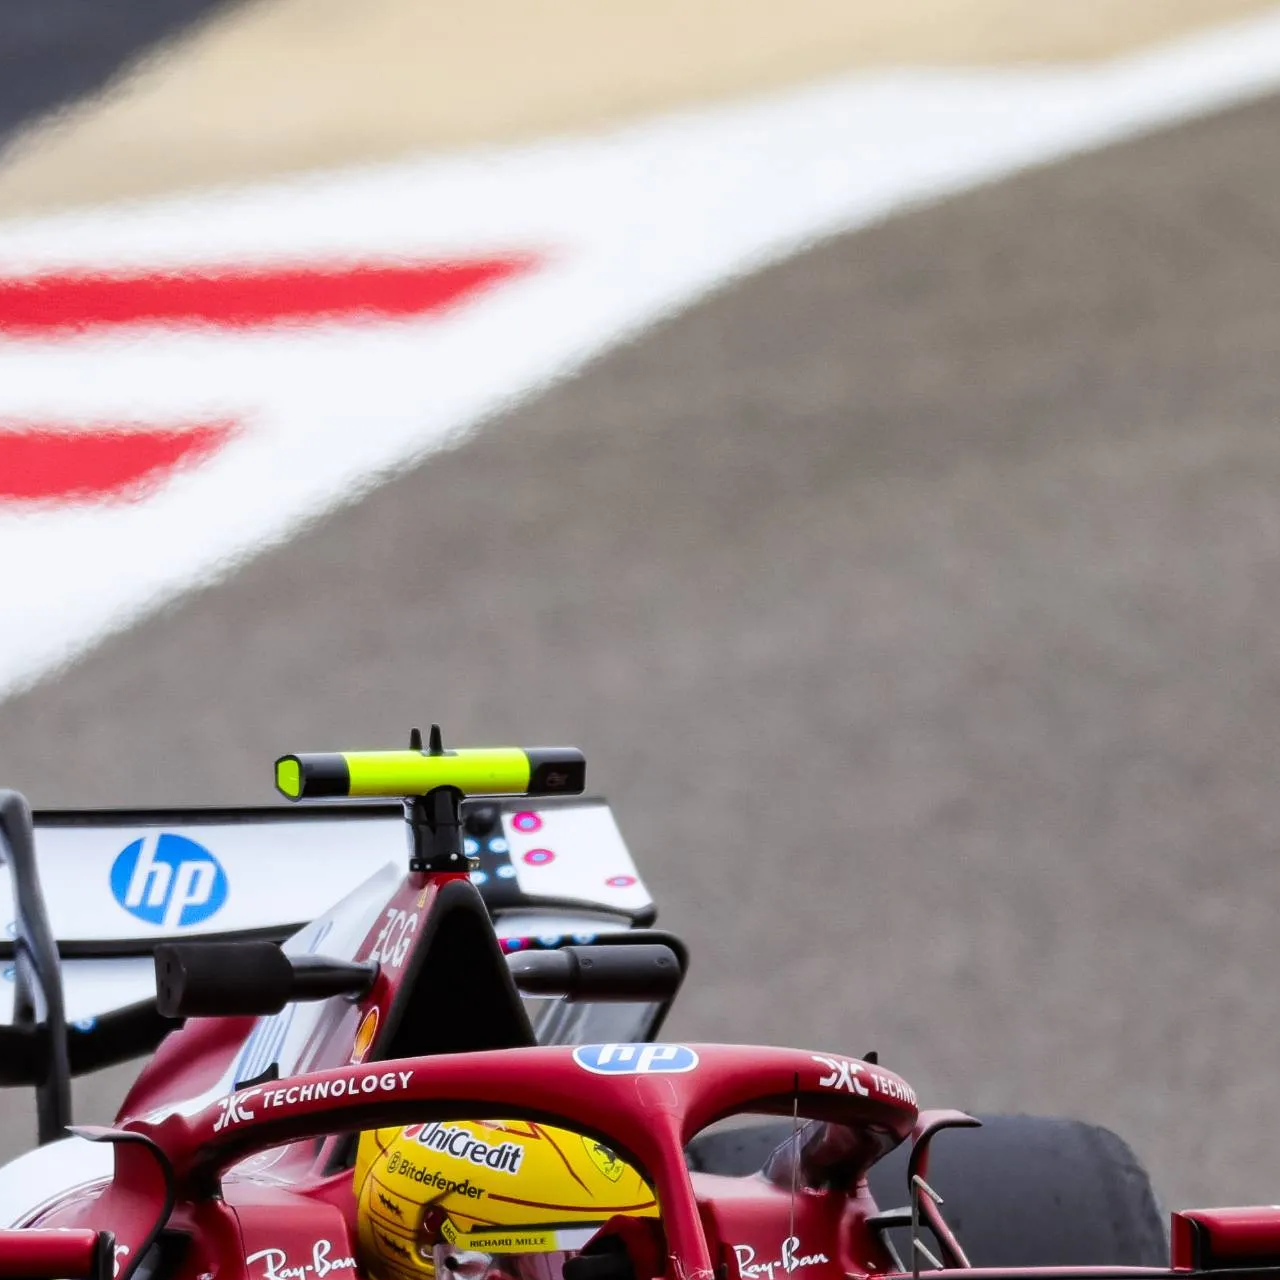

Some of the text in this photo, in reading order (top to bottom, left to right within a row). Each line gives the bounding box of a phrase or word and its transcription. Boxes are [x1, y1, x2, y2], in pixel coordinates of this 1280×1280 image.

[124, 833, 218, 927] hp
[594, 1043, 682, 1072] hp
[263, 1070, 414, 1109] TECHNOLOGY
[420, 1121, 521, 1173] UniCredit
[400, 1159, 486, 1200] Bitdefender
[470, 1236, 546, 1248] RICHARD MILLE
[732, 1236, 830, 1280] Ray-Ban
